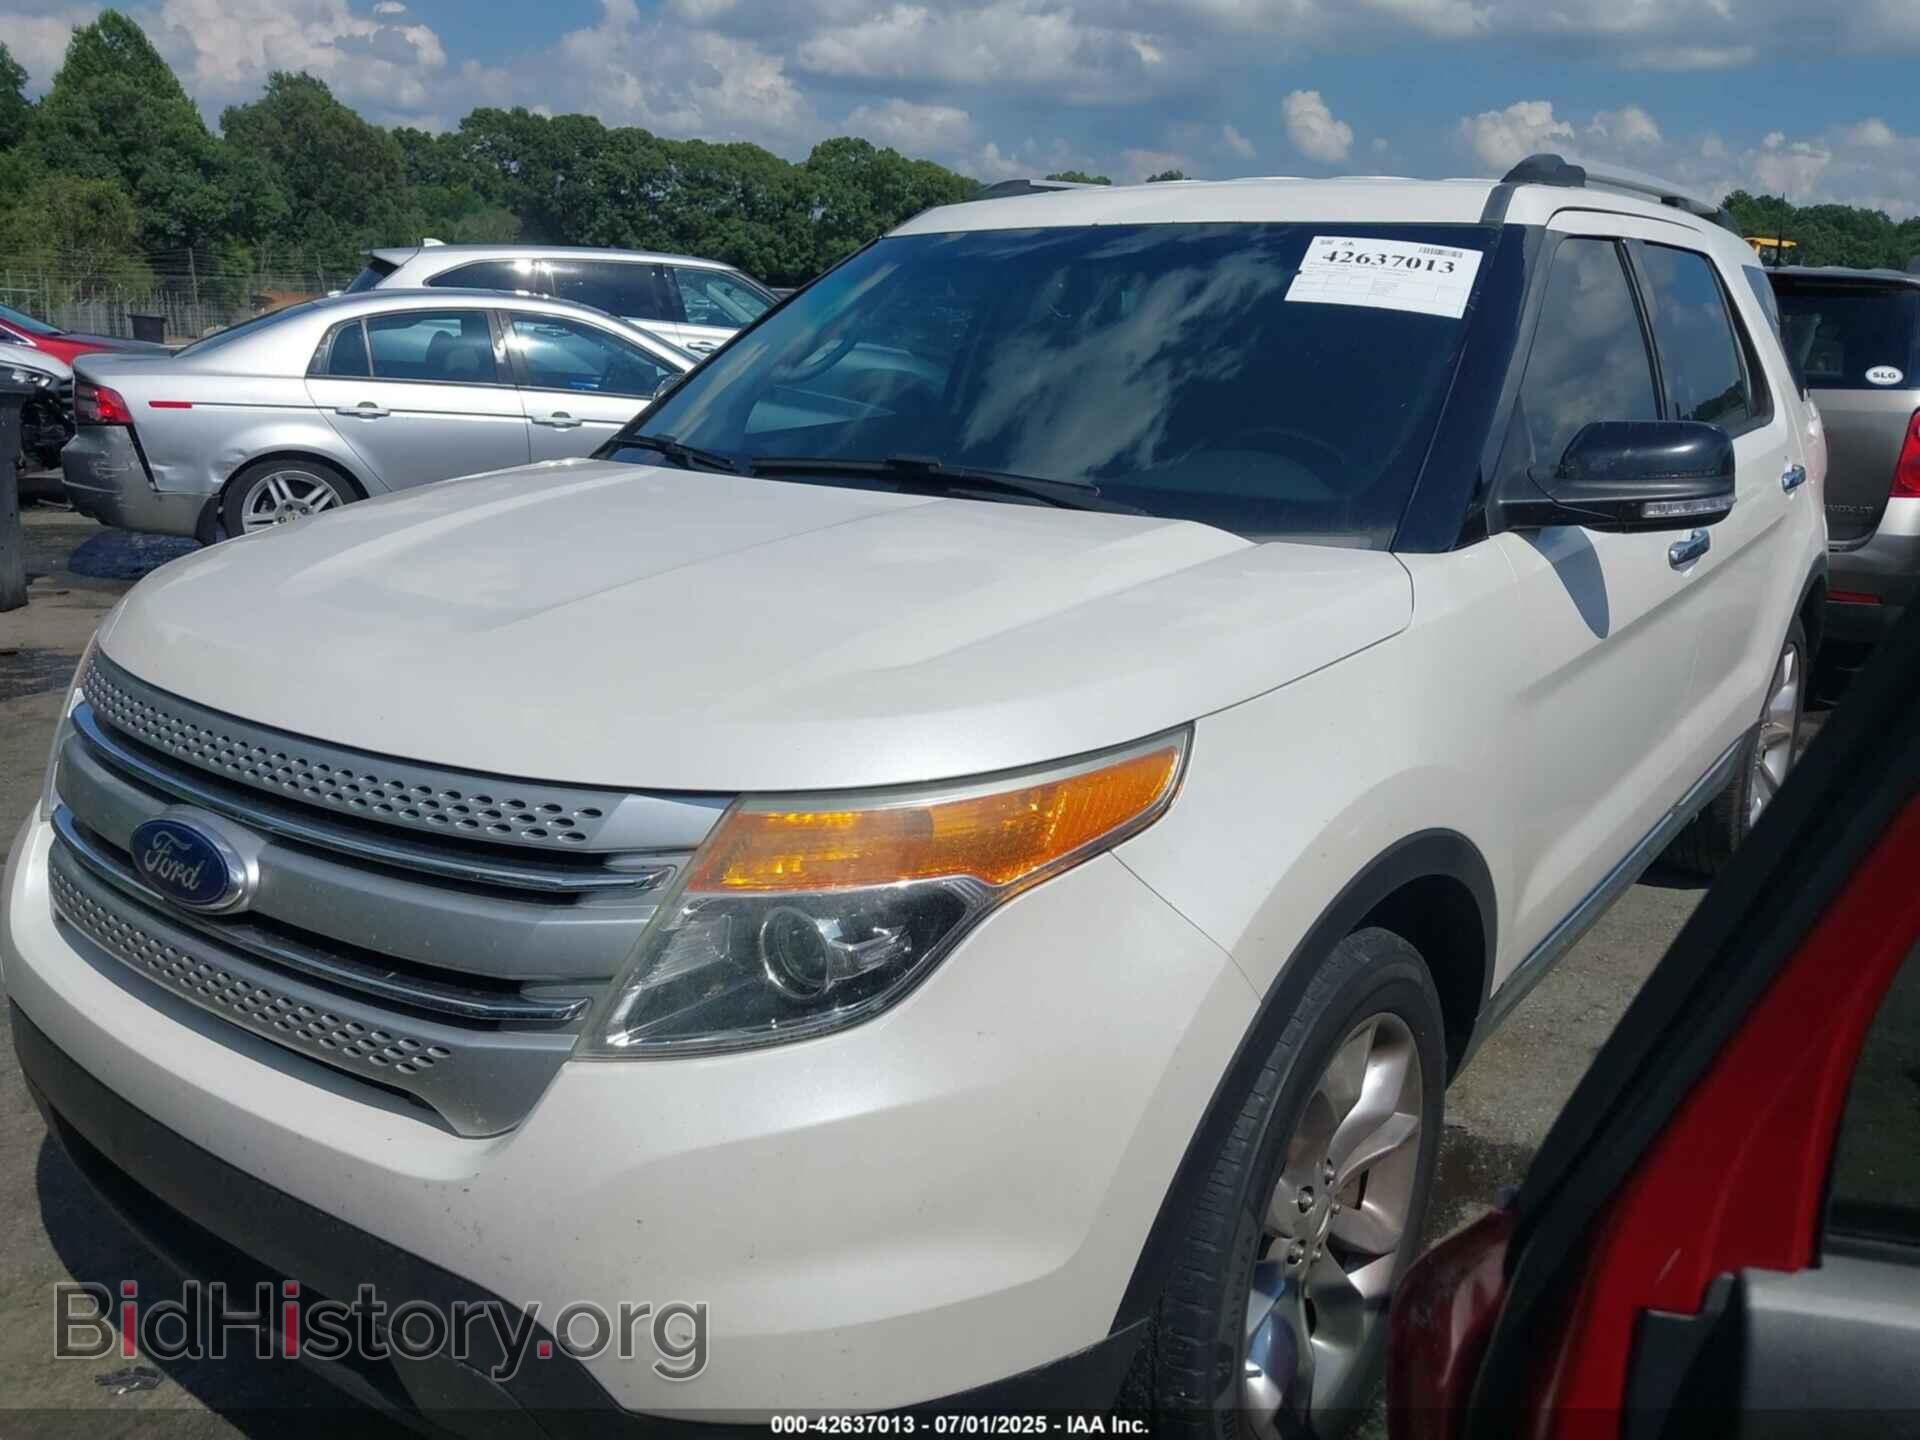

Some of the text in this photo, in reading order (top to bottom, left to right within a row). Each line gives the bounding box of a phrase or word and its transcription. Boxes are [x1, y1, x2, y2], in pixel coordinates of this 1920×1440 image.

[1322, 250, 1455, 274] 42637013
[1872, 371, 1897, 380] SLG
[144, 830, 205, 890] Ford
